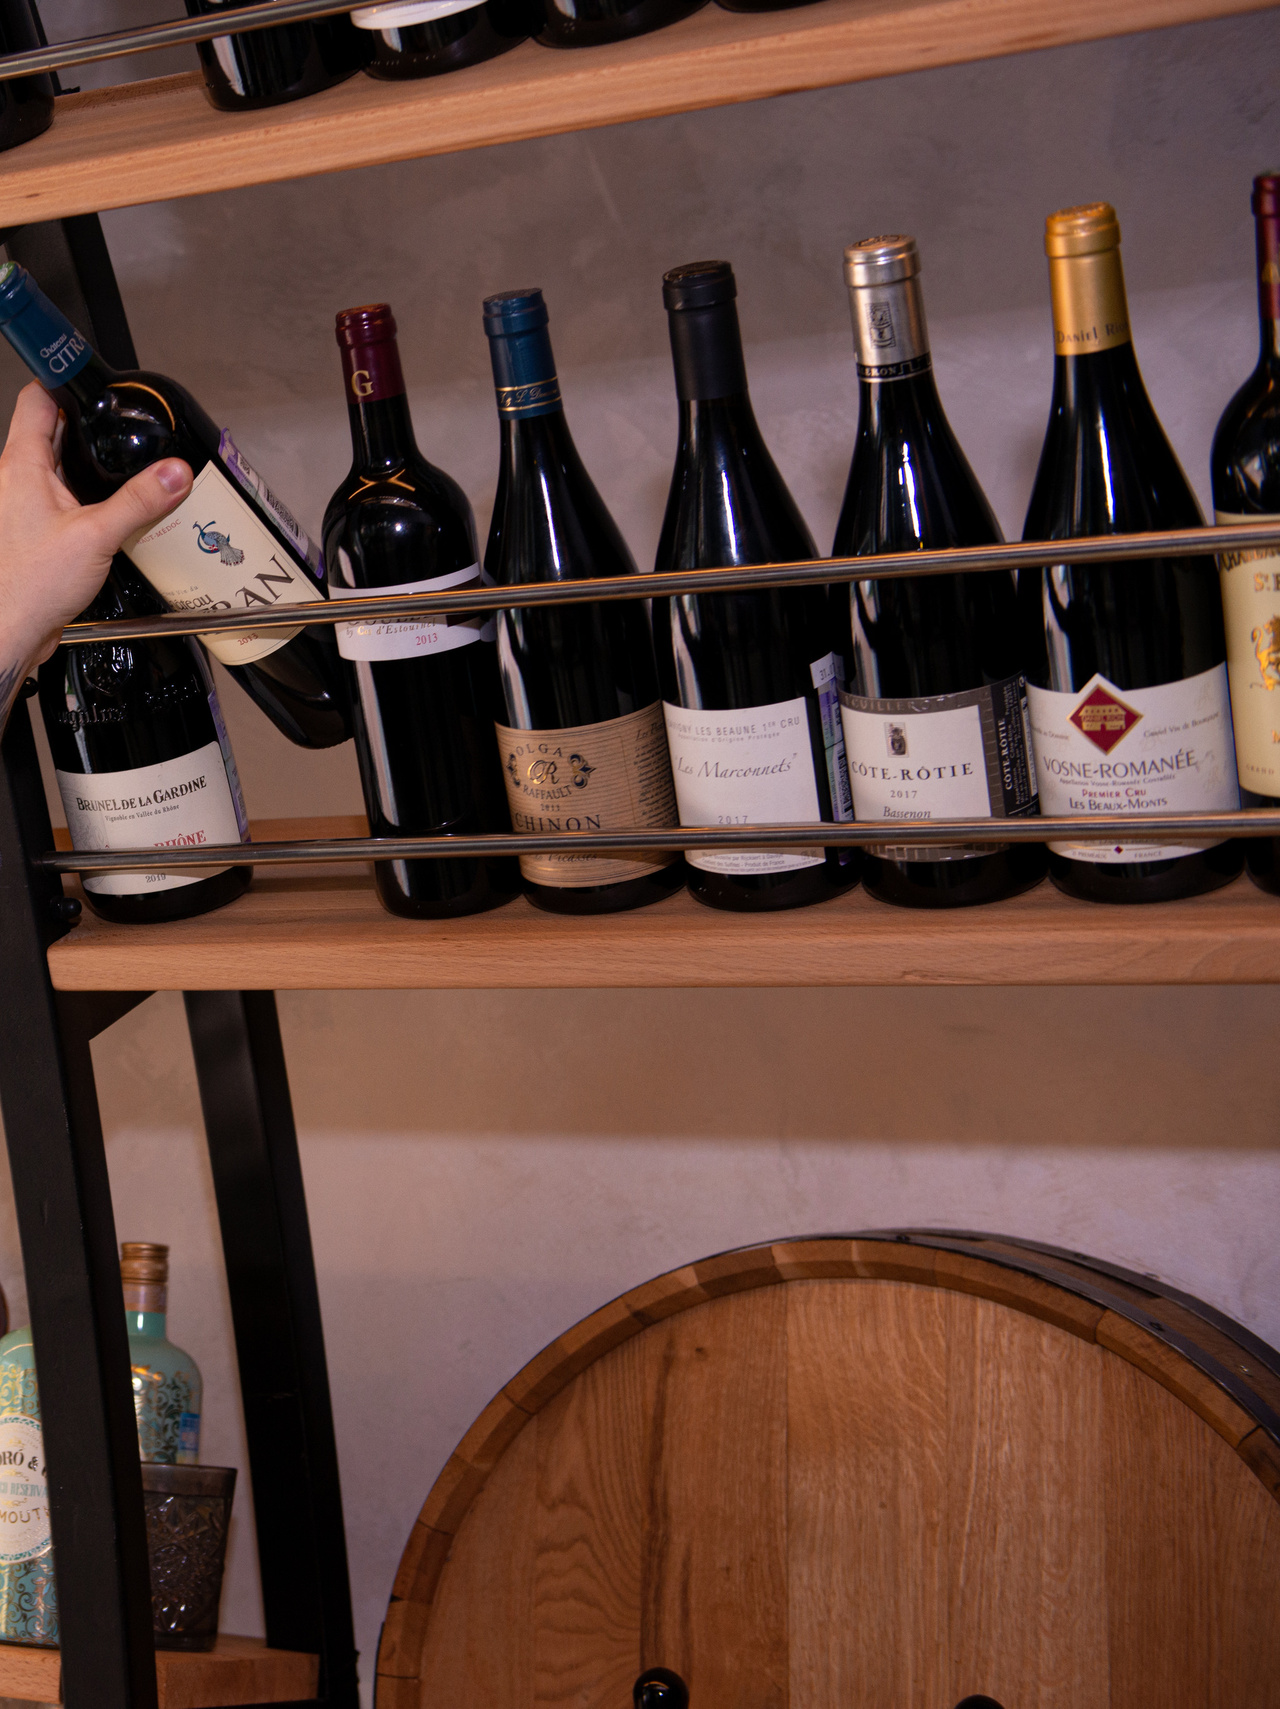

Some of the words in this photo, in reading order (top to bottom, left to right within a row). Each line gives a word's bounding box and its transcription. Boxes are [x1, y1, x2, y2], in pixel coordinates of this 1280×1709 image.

[351, 370, 374, 397] G
[237, 632, 259, 646] 2013
[415, 633, 438, 646] 2013
[695, 726, 712, 736] LES
[716, 724, 756, 737] BEAUNE
[780, 716, 800, 729] CRU
[516, 743, 563, 758] OLGA
[851, 761, 974, 781] CÔTE-RÔTIE
[1043, 748, 1198, 779] VOSNE-ROMANÉE
[76, 797, 121, 812] BRUNEL
[121, 798, 137, 810] DE
[138, 796, 152, 807] LA
[153, 775, 207, 805] GARDINE
[523, 784, 573, 800] RAFFAULT
[890, 790, 918, 799] 2017
[1082, 788, 1120, 798] PREMIER
[1125, 787, 1147, 797] CRU
[1069, 798, 1085, 810] LES
[1089, 796, 1168, 811] BEAUX-MONTS
[105, 813, 129, 823] Vignoble
[136, 809, 153, 819] Vallée
[154, 808, 162, 816] du
[163, 804, 180, 814] Rhône
[718, 815, 748, 825] 2017
[883, 806, 932, 819] Bassenon
[515, 812, 601, 832] CHINON
[145, 873, 167, 884] 2019
[27, 1456, 39, 1471] &
